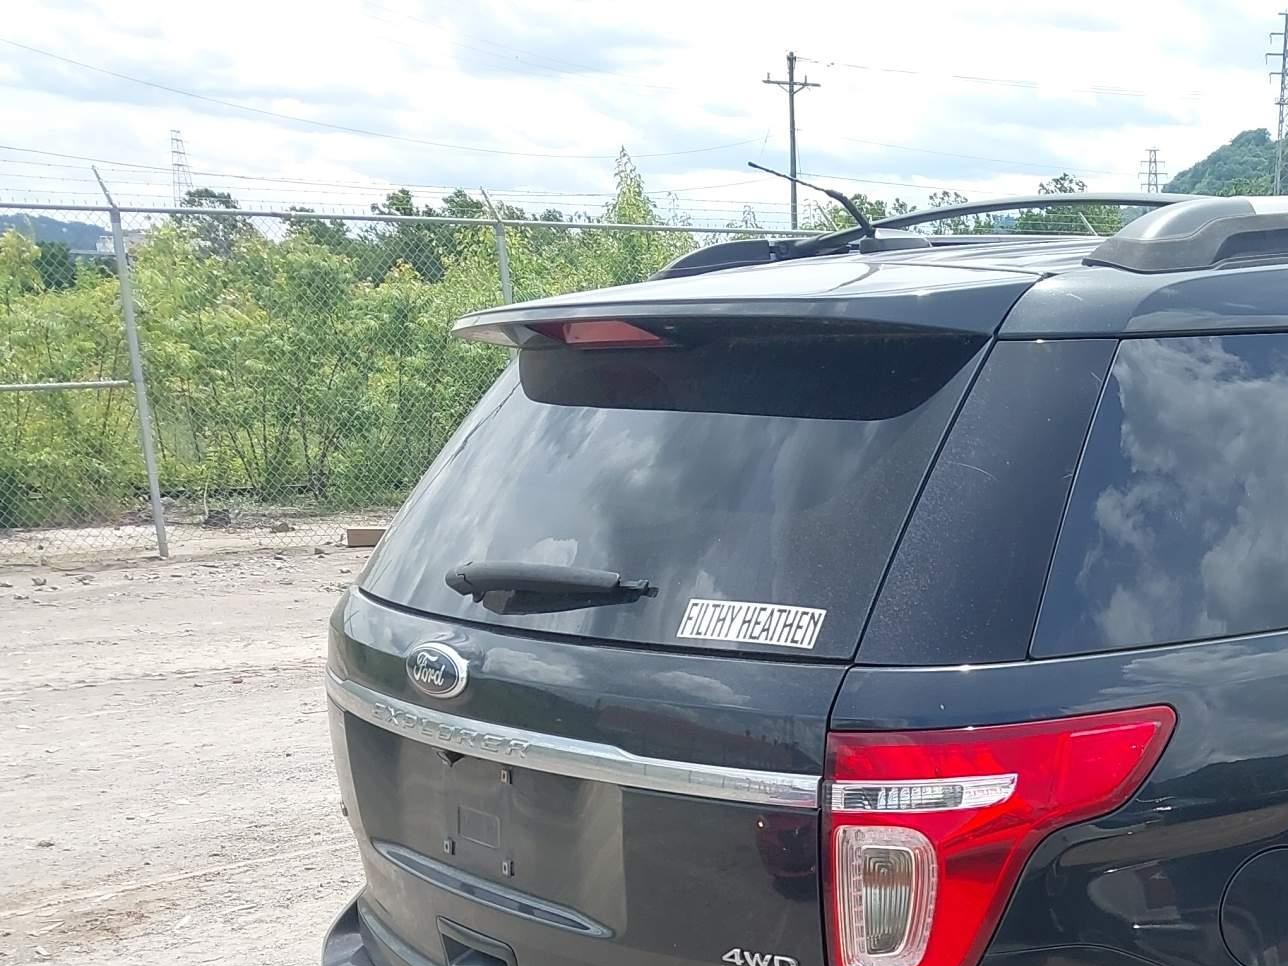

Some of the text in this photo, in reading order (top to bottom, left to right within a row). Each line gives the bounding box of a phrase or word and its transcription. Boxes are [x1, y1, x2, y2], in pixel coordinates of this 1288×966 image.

[680, 602, 823, 647] FILTHY HEATHEN
[413, 651, 447, 686] Ford
[371, 702, 530, 759] EXPLORER
